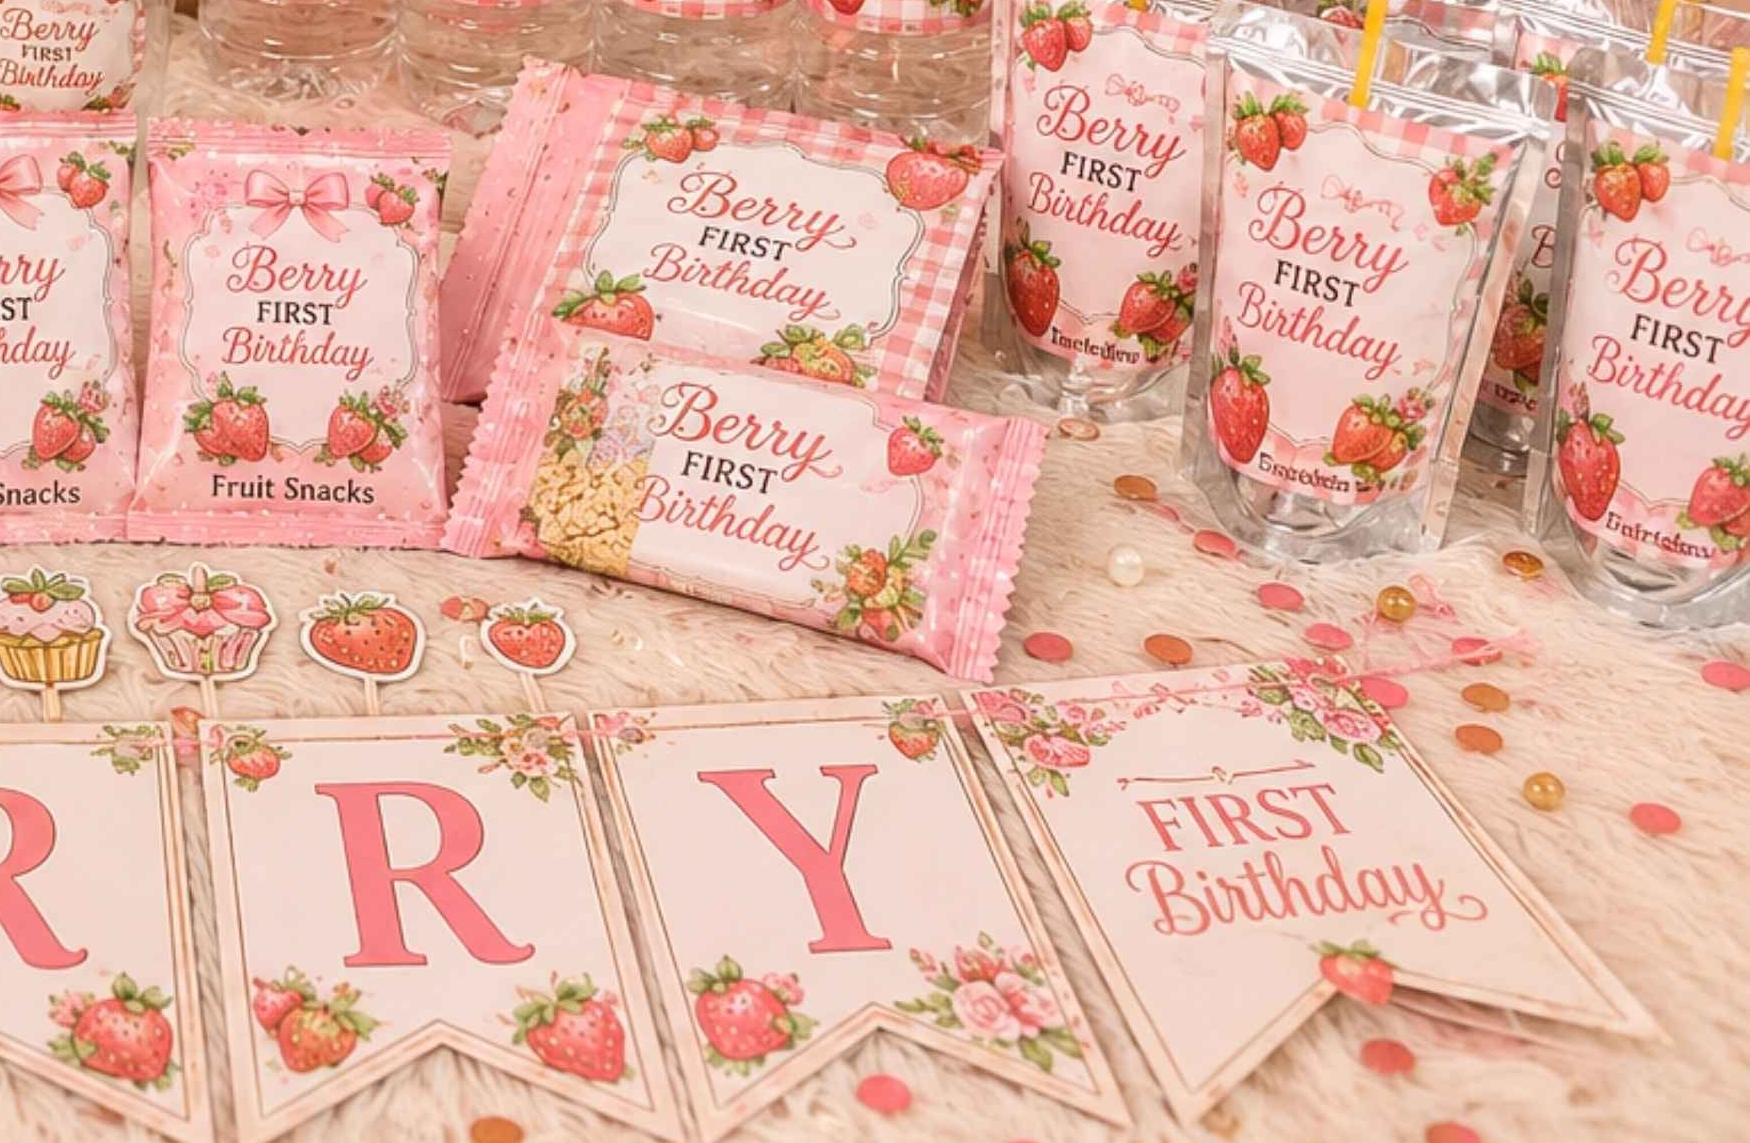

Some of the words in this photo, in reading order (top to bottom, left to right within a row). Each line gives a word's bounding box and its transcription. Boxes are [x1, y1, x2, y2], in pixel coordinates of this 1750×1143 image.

[0, 7, 99, 52] Berry
[1036, 82, 1186, 178] Berry
[1061, 152, 1142, 193] FIRST
[667, 163, 856, 250] Berry
[1028, 171, 1181, 258] Birthday
[1249, 185, 1408, 293] Berry
[226, 243, 368, 309] Berry
[697, 226, 792, 261] FIRST
[257, 301, 333, 325] FIRST
[643, 242, 840, 323] Birthday
[1274, 259, 1361, 307] FIRST
[222, 326, 374, 380] Birthday
[1237, 281, 1401, 380] Birthday
[1630, 313, 1724, 364] FIRST
[650, 382, 843, 482] Berry
[212, 474, 275, 499] Fruit
[283, 477, 374, 504] Snacks
[680, 451, 777, 494] FIRST
[632, 475, 830, 572] Birthday
[1135, 783, 1351, 852] FIRST
[1126, 845, 1488, 936] Birthday
